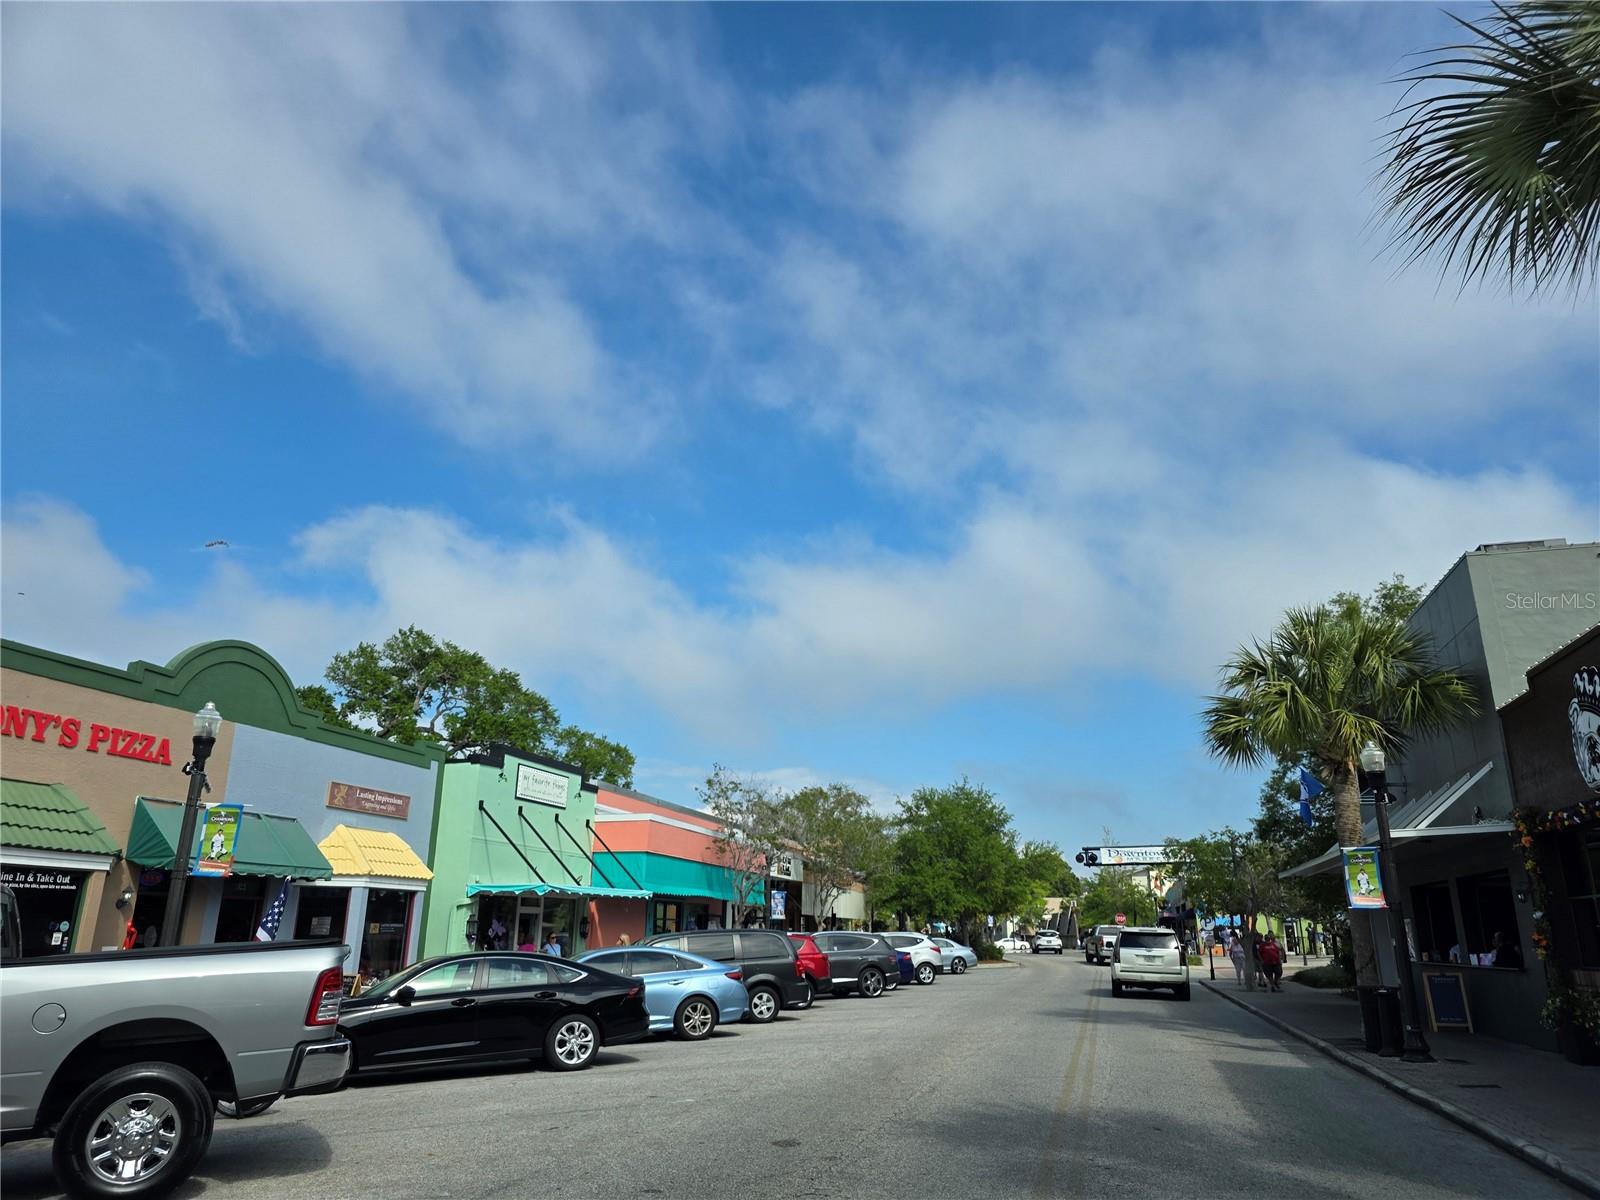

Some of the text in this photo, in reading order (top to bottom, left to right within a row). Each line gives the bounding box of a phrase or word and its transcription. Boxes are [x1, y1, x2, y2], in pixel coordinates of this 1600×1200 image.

[87, 723, 172, 766] PIZZA
[356, 788, 376, 801] Lasting
[1108, 849, 1166, 857] Downtow
[0, 872, 70, 884] ine In & Take Out
